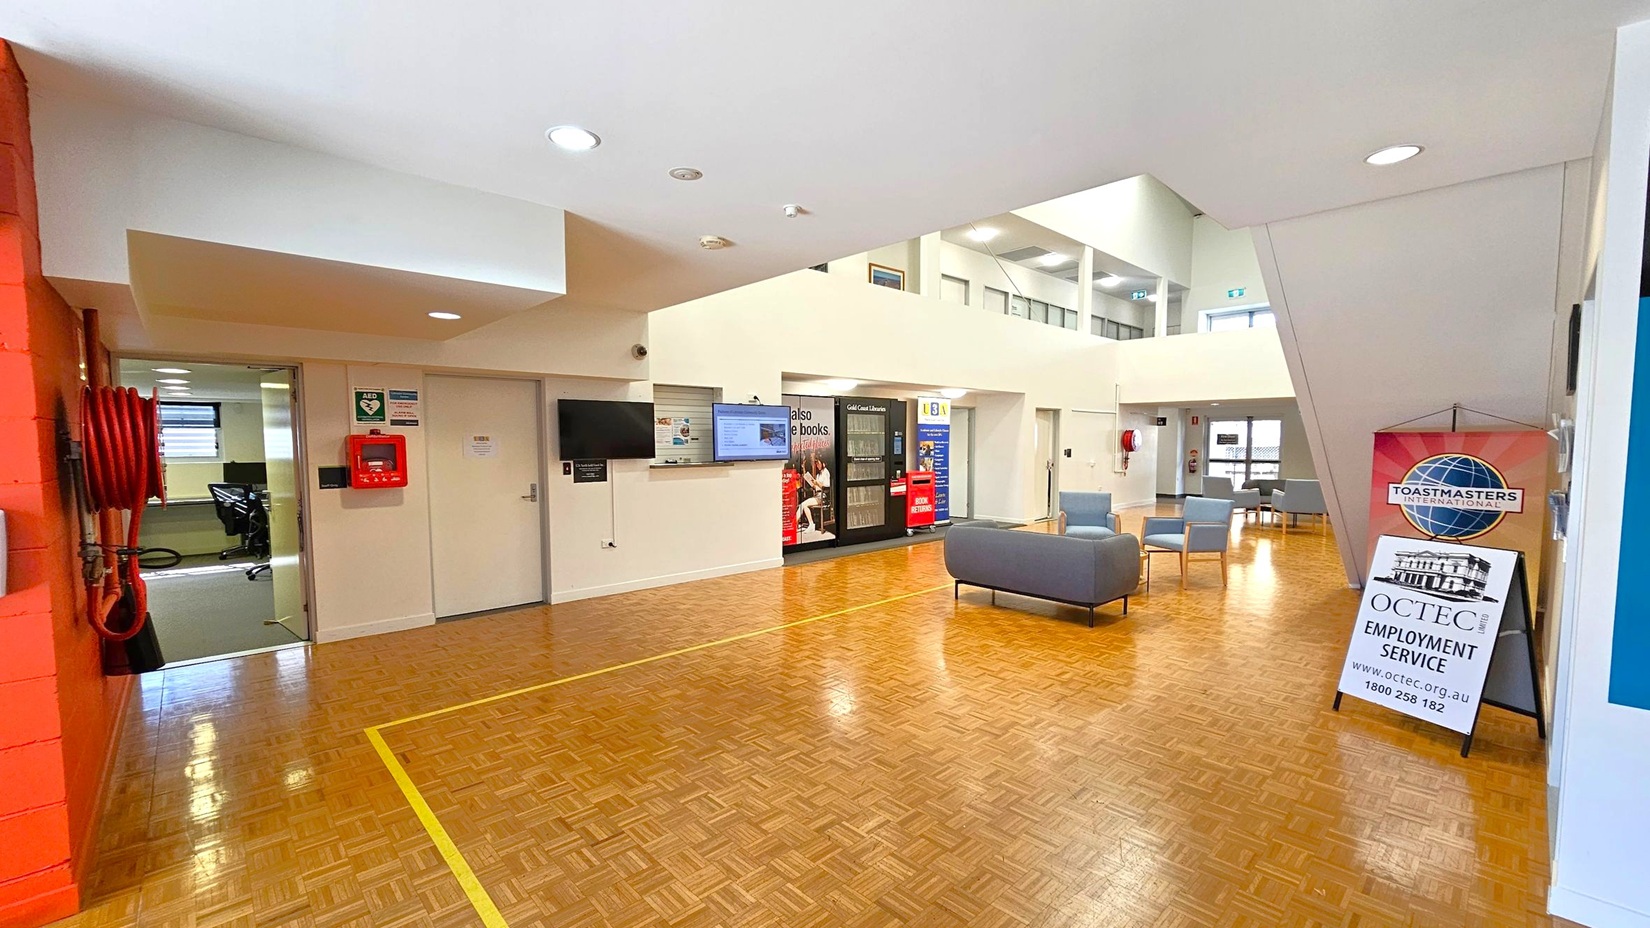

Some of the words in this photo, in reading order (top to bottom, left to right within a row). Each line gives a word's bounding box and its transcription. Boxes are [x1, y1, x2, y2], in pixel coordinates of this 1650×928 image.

[791, 407, 812, 421] also
[922, 402, 948, 416] U3A
[800, 422, 831, 436] books.
[915, 497, 929, 505] BOOK
[1392, 486, 1518, 502] TOASTMASTERS
[1404, 496, 1501, 508] INTERNATIONAL
[911, 504, 932, 514] RETURNS
[1370, 593, 1477, 631] OCTEC
[1477, 613, 1490, 635] LIMITED
[1364, 620, 1478, 661] EMPLOYMENT
[1380, 643, 1447, 674] SERVICE
[1352, 661, 1470, 703] www.octec.org.au
[1365, 680, 1392, 696] 1800
[1394, 690, 1418, 704] 258
[1422, 699, 1445, 713] 182
